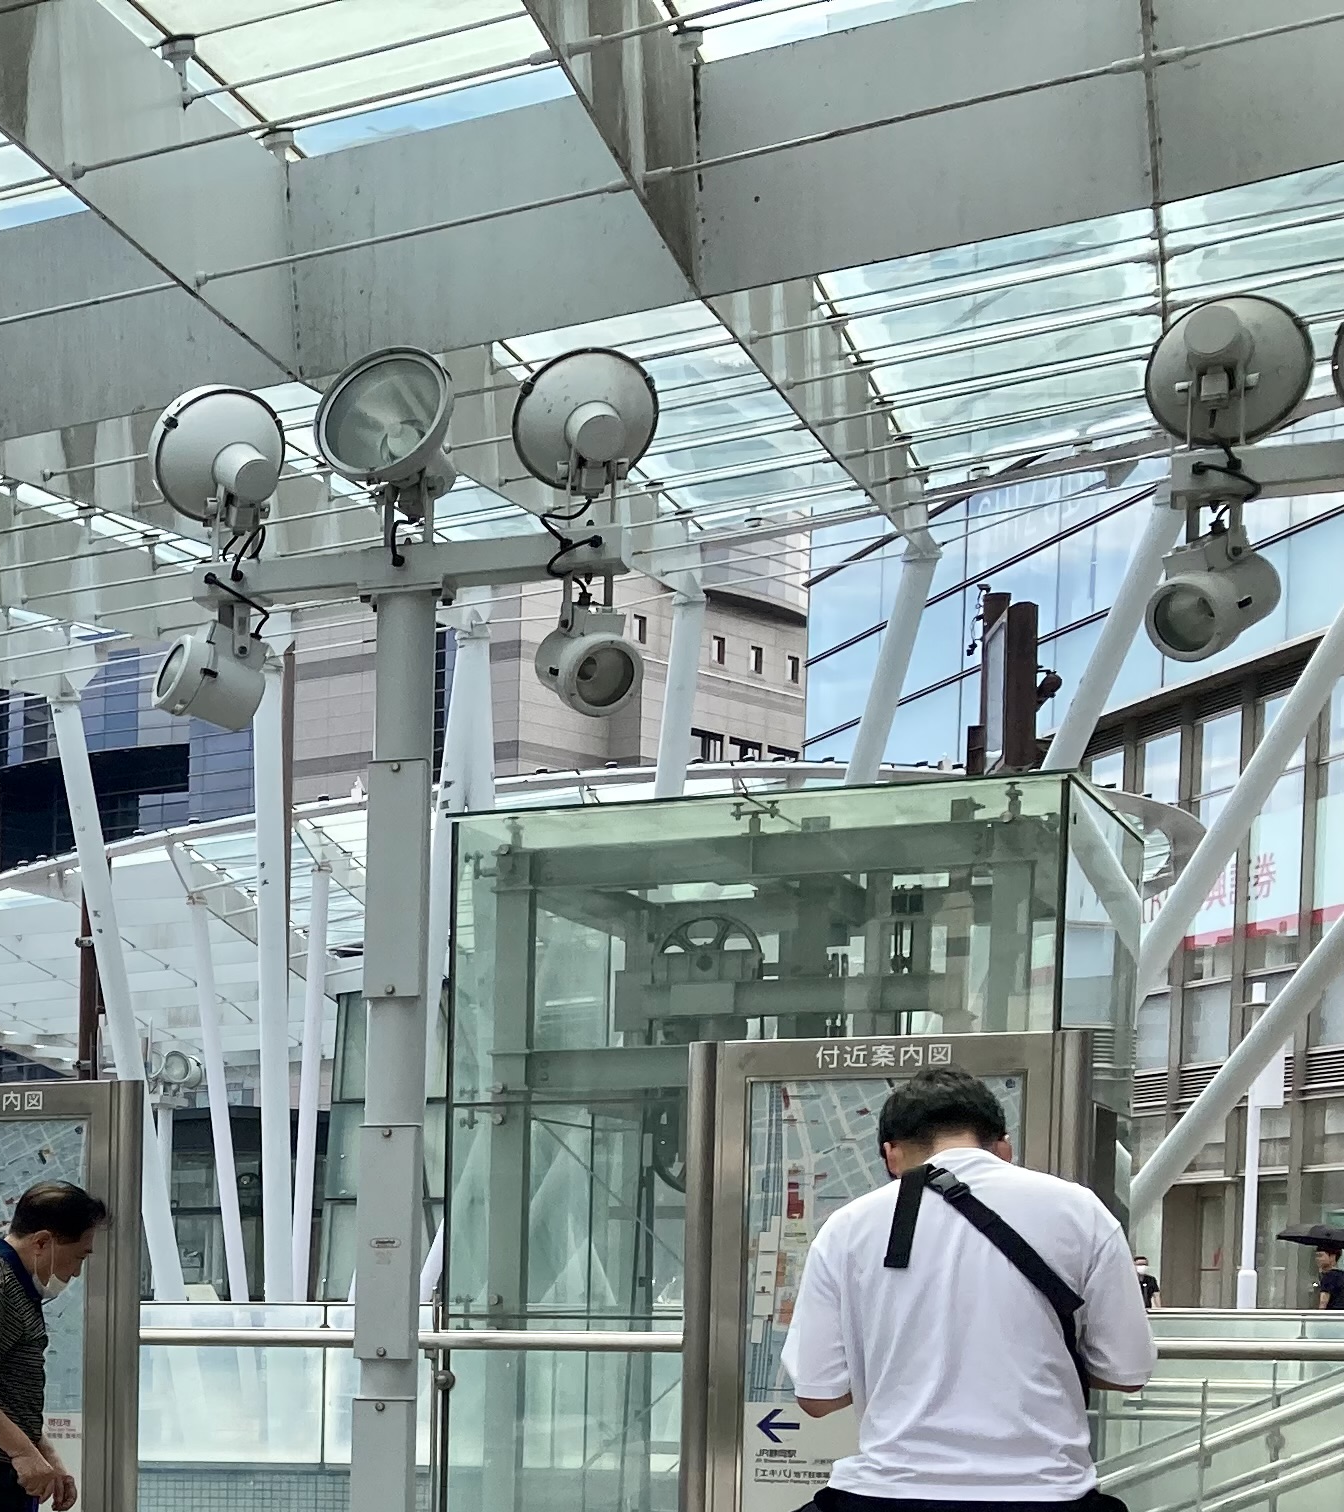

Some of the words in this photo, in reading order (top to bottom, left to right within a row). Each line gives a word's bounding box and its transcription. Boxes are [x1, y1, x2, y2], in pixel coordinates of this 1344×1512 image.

[816, 1043, 952, 1069] 付近案内図
